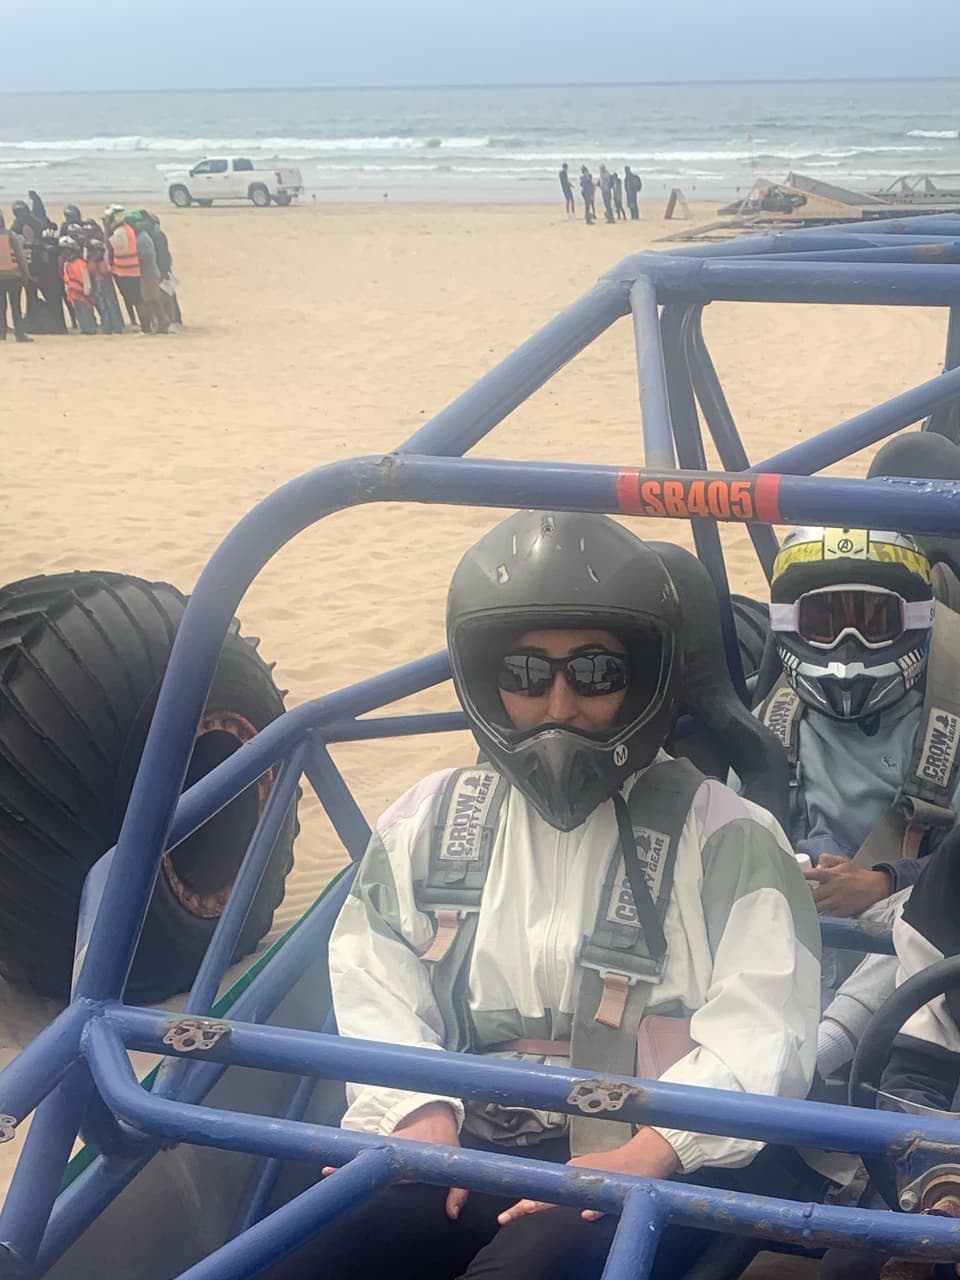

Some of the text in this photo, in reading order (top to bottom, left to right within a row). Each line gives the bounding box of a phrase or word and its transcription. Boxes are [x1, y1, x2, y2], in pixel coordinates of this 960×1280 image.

[641, 480, 753, 519] SB405
[616, 747, 626, 763] M
[923, 728, 948, 779] CROW
[937, 718, 957, 782] SAFETY GEAR
[447, 793, 477, 857] CROW
[465, 775, 494, 856] SAFETY GEAR
[649, 837, 665, 873] GEAR
